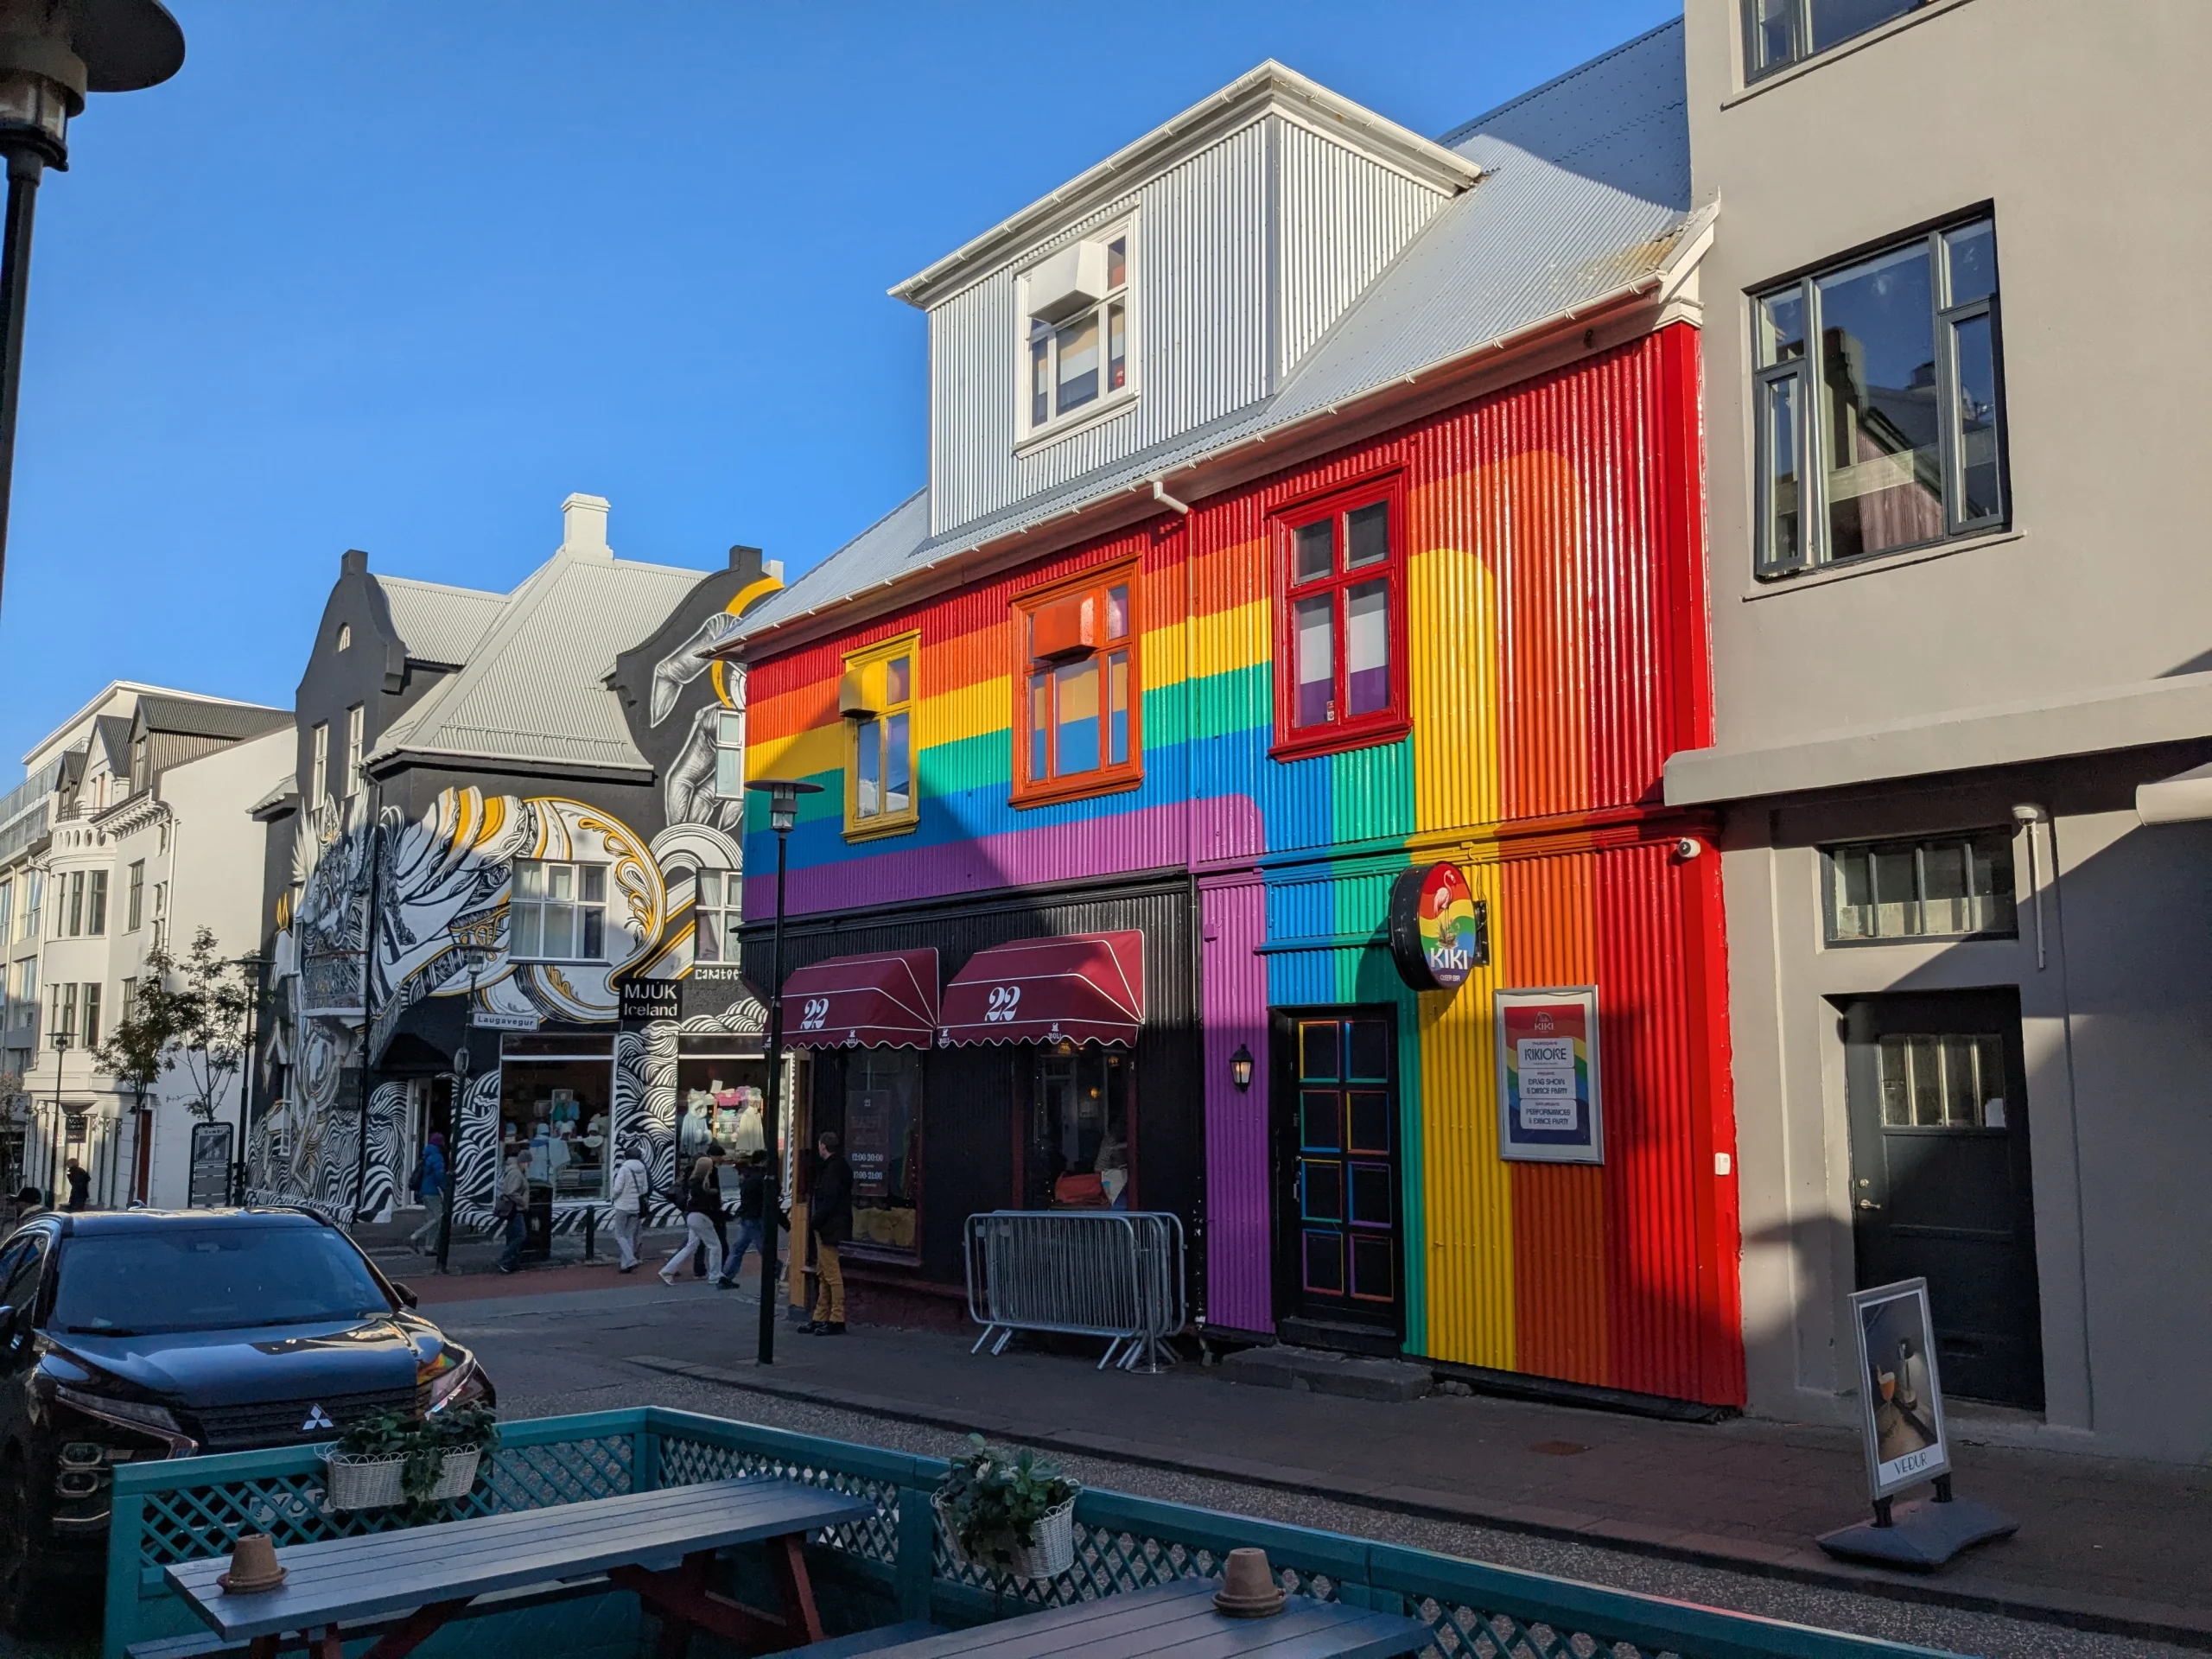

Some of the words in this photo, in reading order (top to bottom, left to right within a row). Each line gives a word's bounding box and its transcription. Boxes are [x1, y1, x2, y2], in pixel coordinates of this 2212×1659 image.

[1430, 947, 1468, 970] KIKI
[625, 982, 677, 1000] MJÚK
[624, 1003, 677, 1017] Iceland
[984, 986, 1020, 1021] 22
[478, 1015, 534, 1027] Laugavegur
[800, 998, 829, 1030] 22
[1534, 1022, 1554, 1031] KIKI
